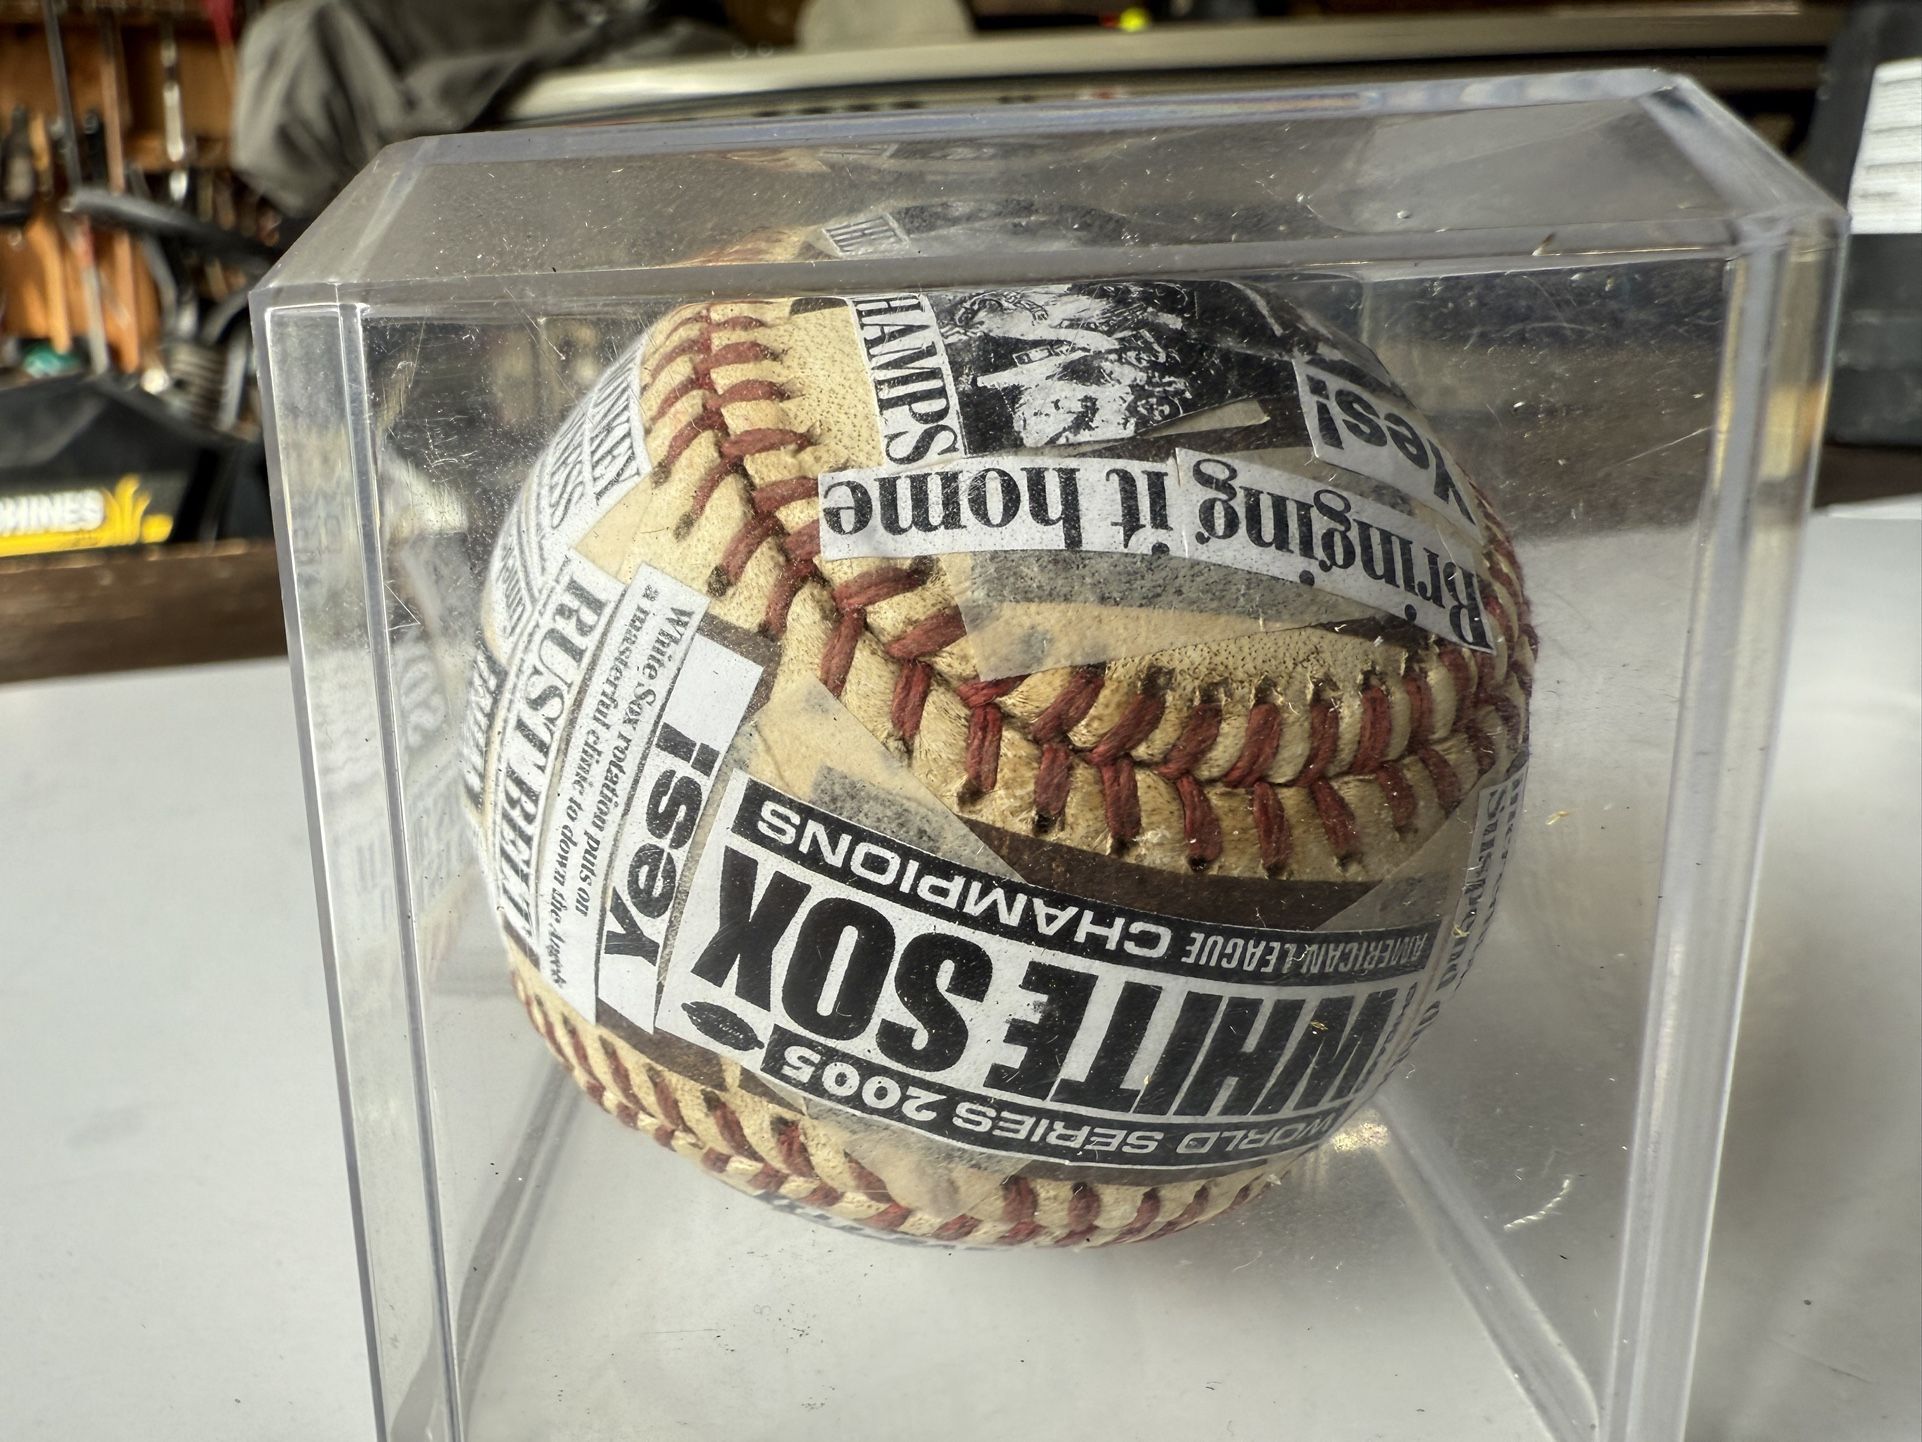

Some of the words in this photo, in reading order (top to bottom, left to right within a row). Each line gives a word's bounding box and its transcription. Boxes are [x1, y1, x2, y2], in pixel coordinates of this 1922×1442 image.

[855, 294, 960, 465] HAMPS
[1305, 374, 1477, 526] Yes!
[823, 467, 1083, 550] home
[1106, 467, 1174, 555] it
[1192, 458, 1494, 650] Bringing
[642, 584, 659, 602] a
[513, 573, 610, 776] RUST
[593, 603, 650, 731] masterful
[642, 606, 695, 681] White
[622, 682, 658, 732] Sox
[573, 728, 604, 797] clinic
[592, 731, 632, 832] rotation
[566, 796, 584, 823] to
[604, 721, 721, 967] Yes!
[499, 762, 542, 938] BELT
[553, 824, 578, 887] down
[579, 829, 601, 888] puts
[757, 799, 1172, 959] CHAMPIONS
[550, 887, 568, 924] the
[574, 886, 591, 917] on
[690, 845, 993, 1073] SOX
[1180, 931, 1293, 975] LEAGUE
[1303, 933, 1429, 974] AMERICAN
[983, 960, 1399, 1116] WHITE
[781, 1045, 947, 1122] 2005
[952, 1101, 1166, 1153] SERIES
[1176, 1112, 1336, 1154] WORLD
